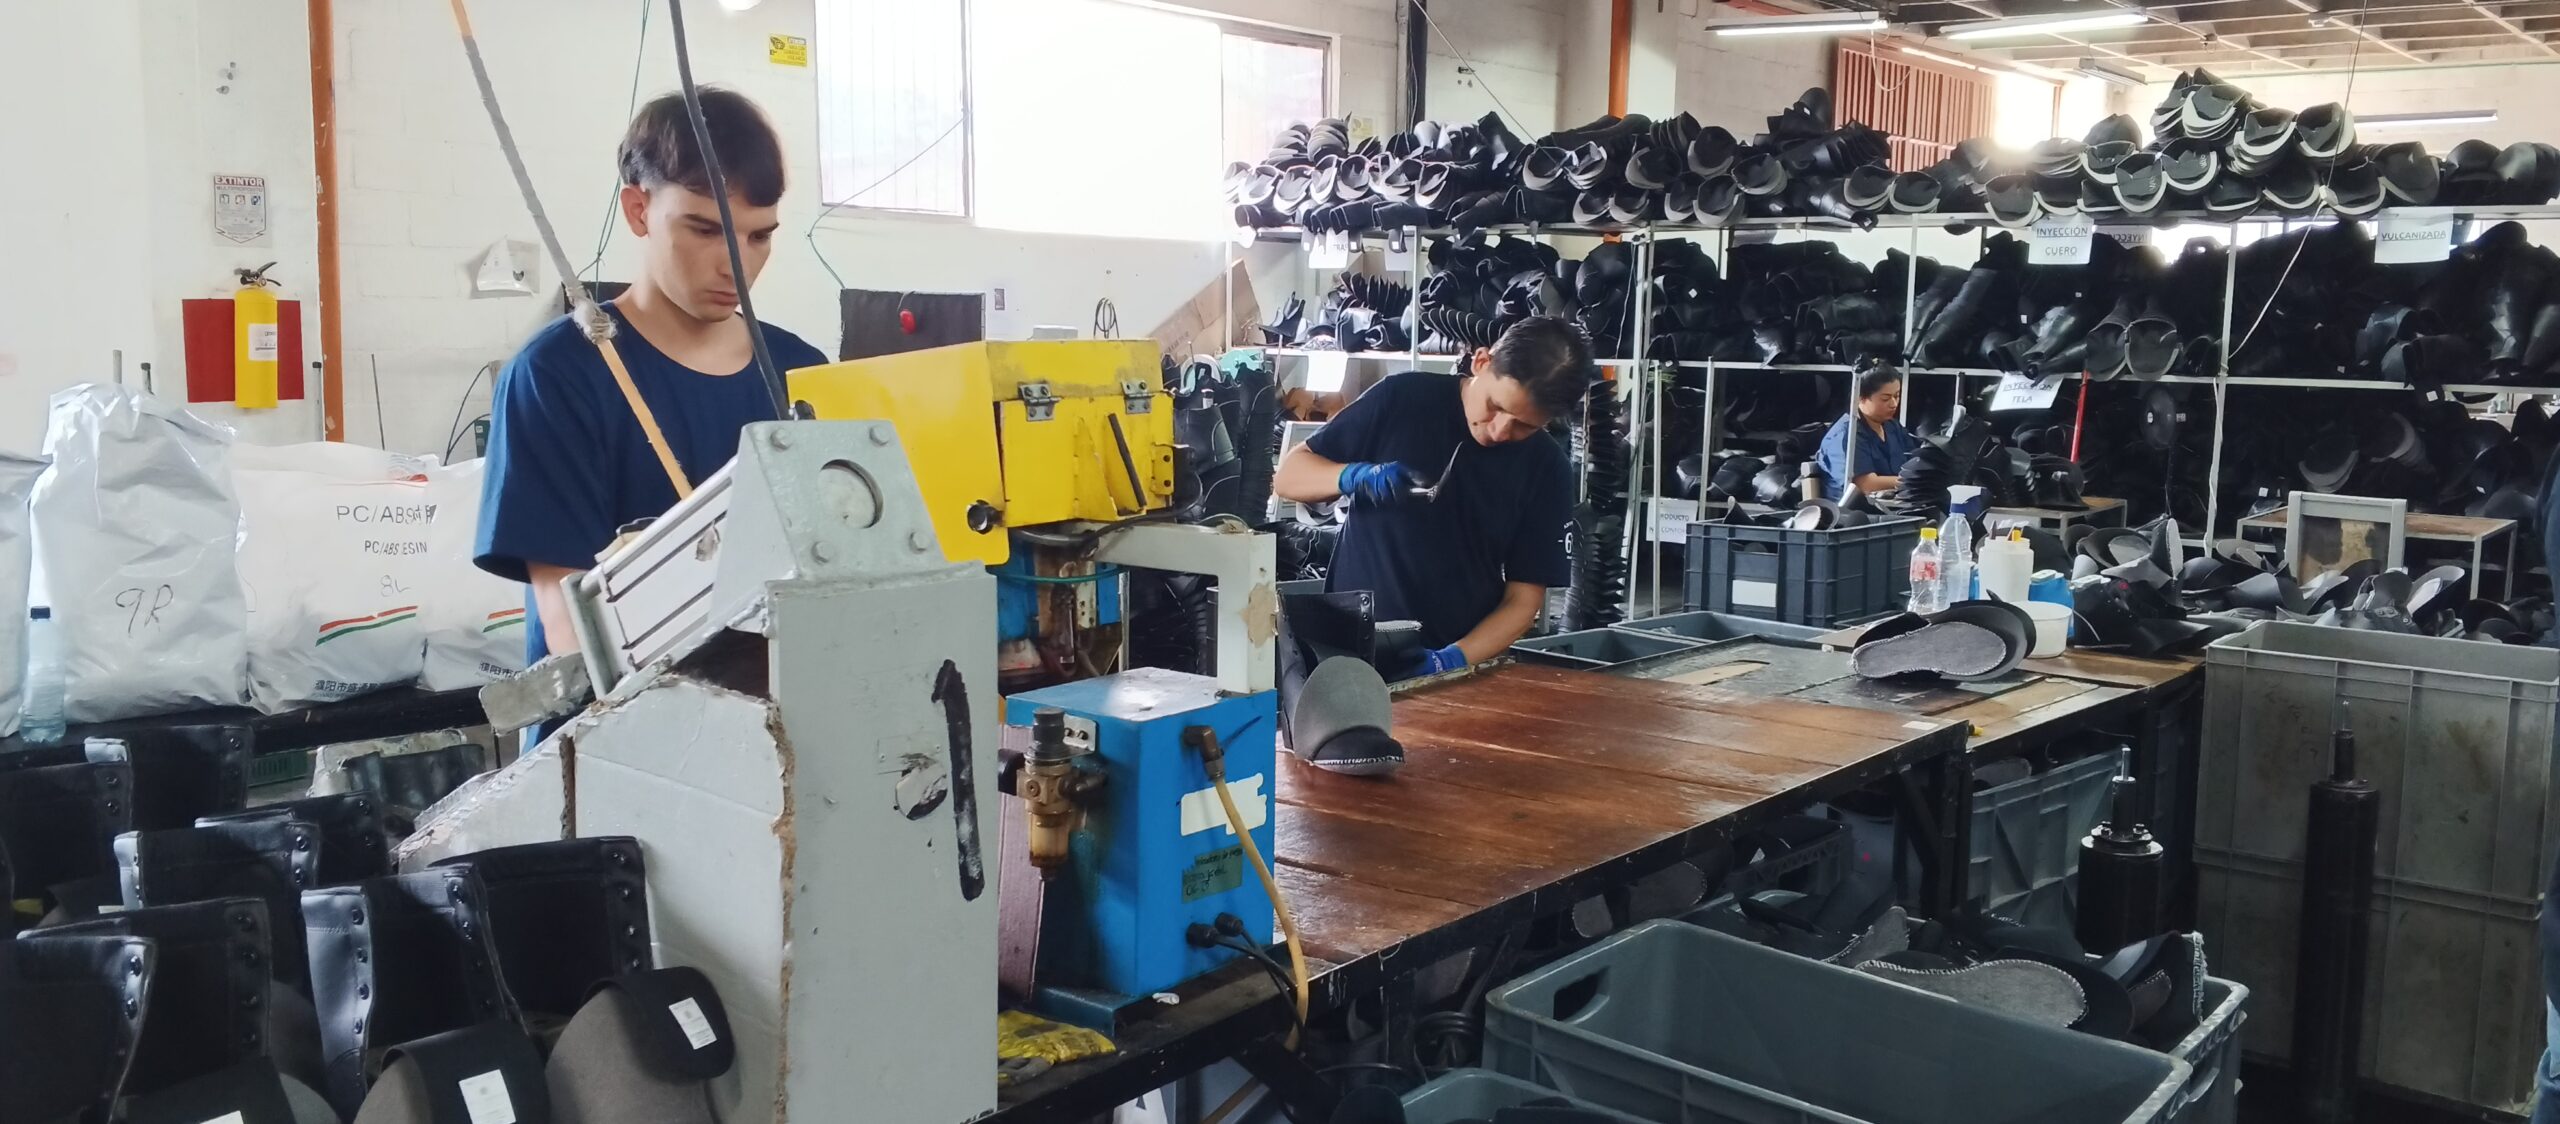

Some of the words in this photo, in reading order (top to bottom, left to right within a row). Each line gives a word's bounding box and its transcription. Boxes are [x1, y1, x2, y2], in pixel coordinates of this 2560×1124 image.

[215, 176, 264, 187] EXTINTOR
[2036, 226, 2088, 236] INYECCIÓN
[2381, 230, 2447, 240] VULCANIZADA
[2045, 246, 2078, 257] CUERO
[2012, 395, 2033, 404] TELA
[364, 540, 400, 555] PC/ABS
